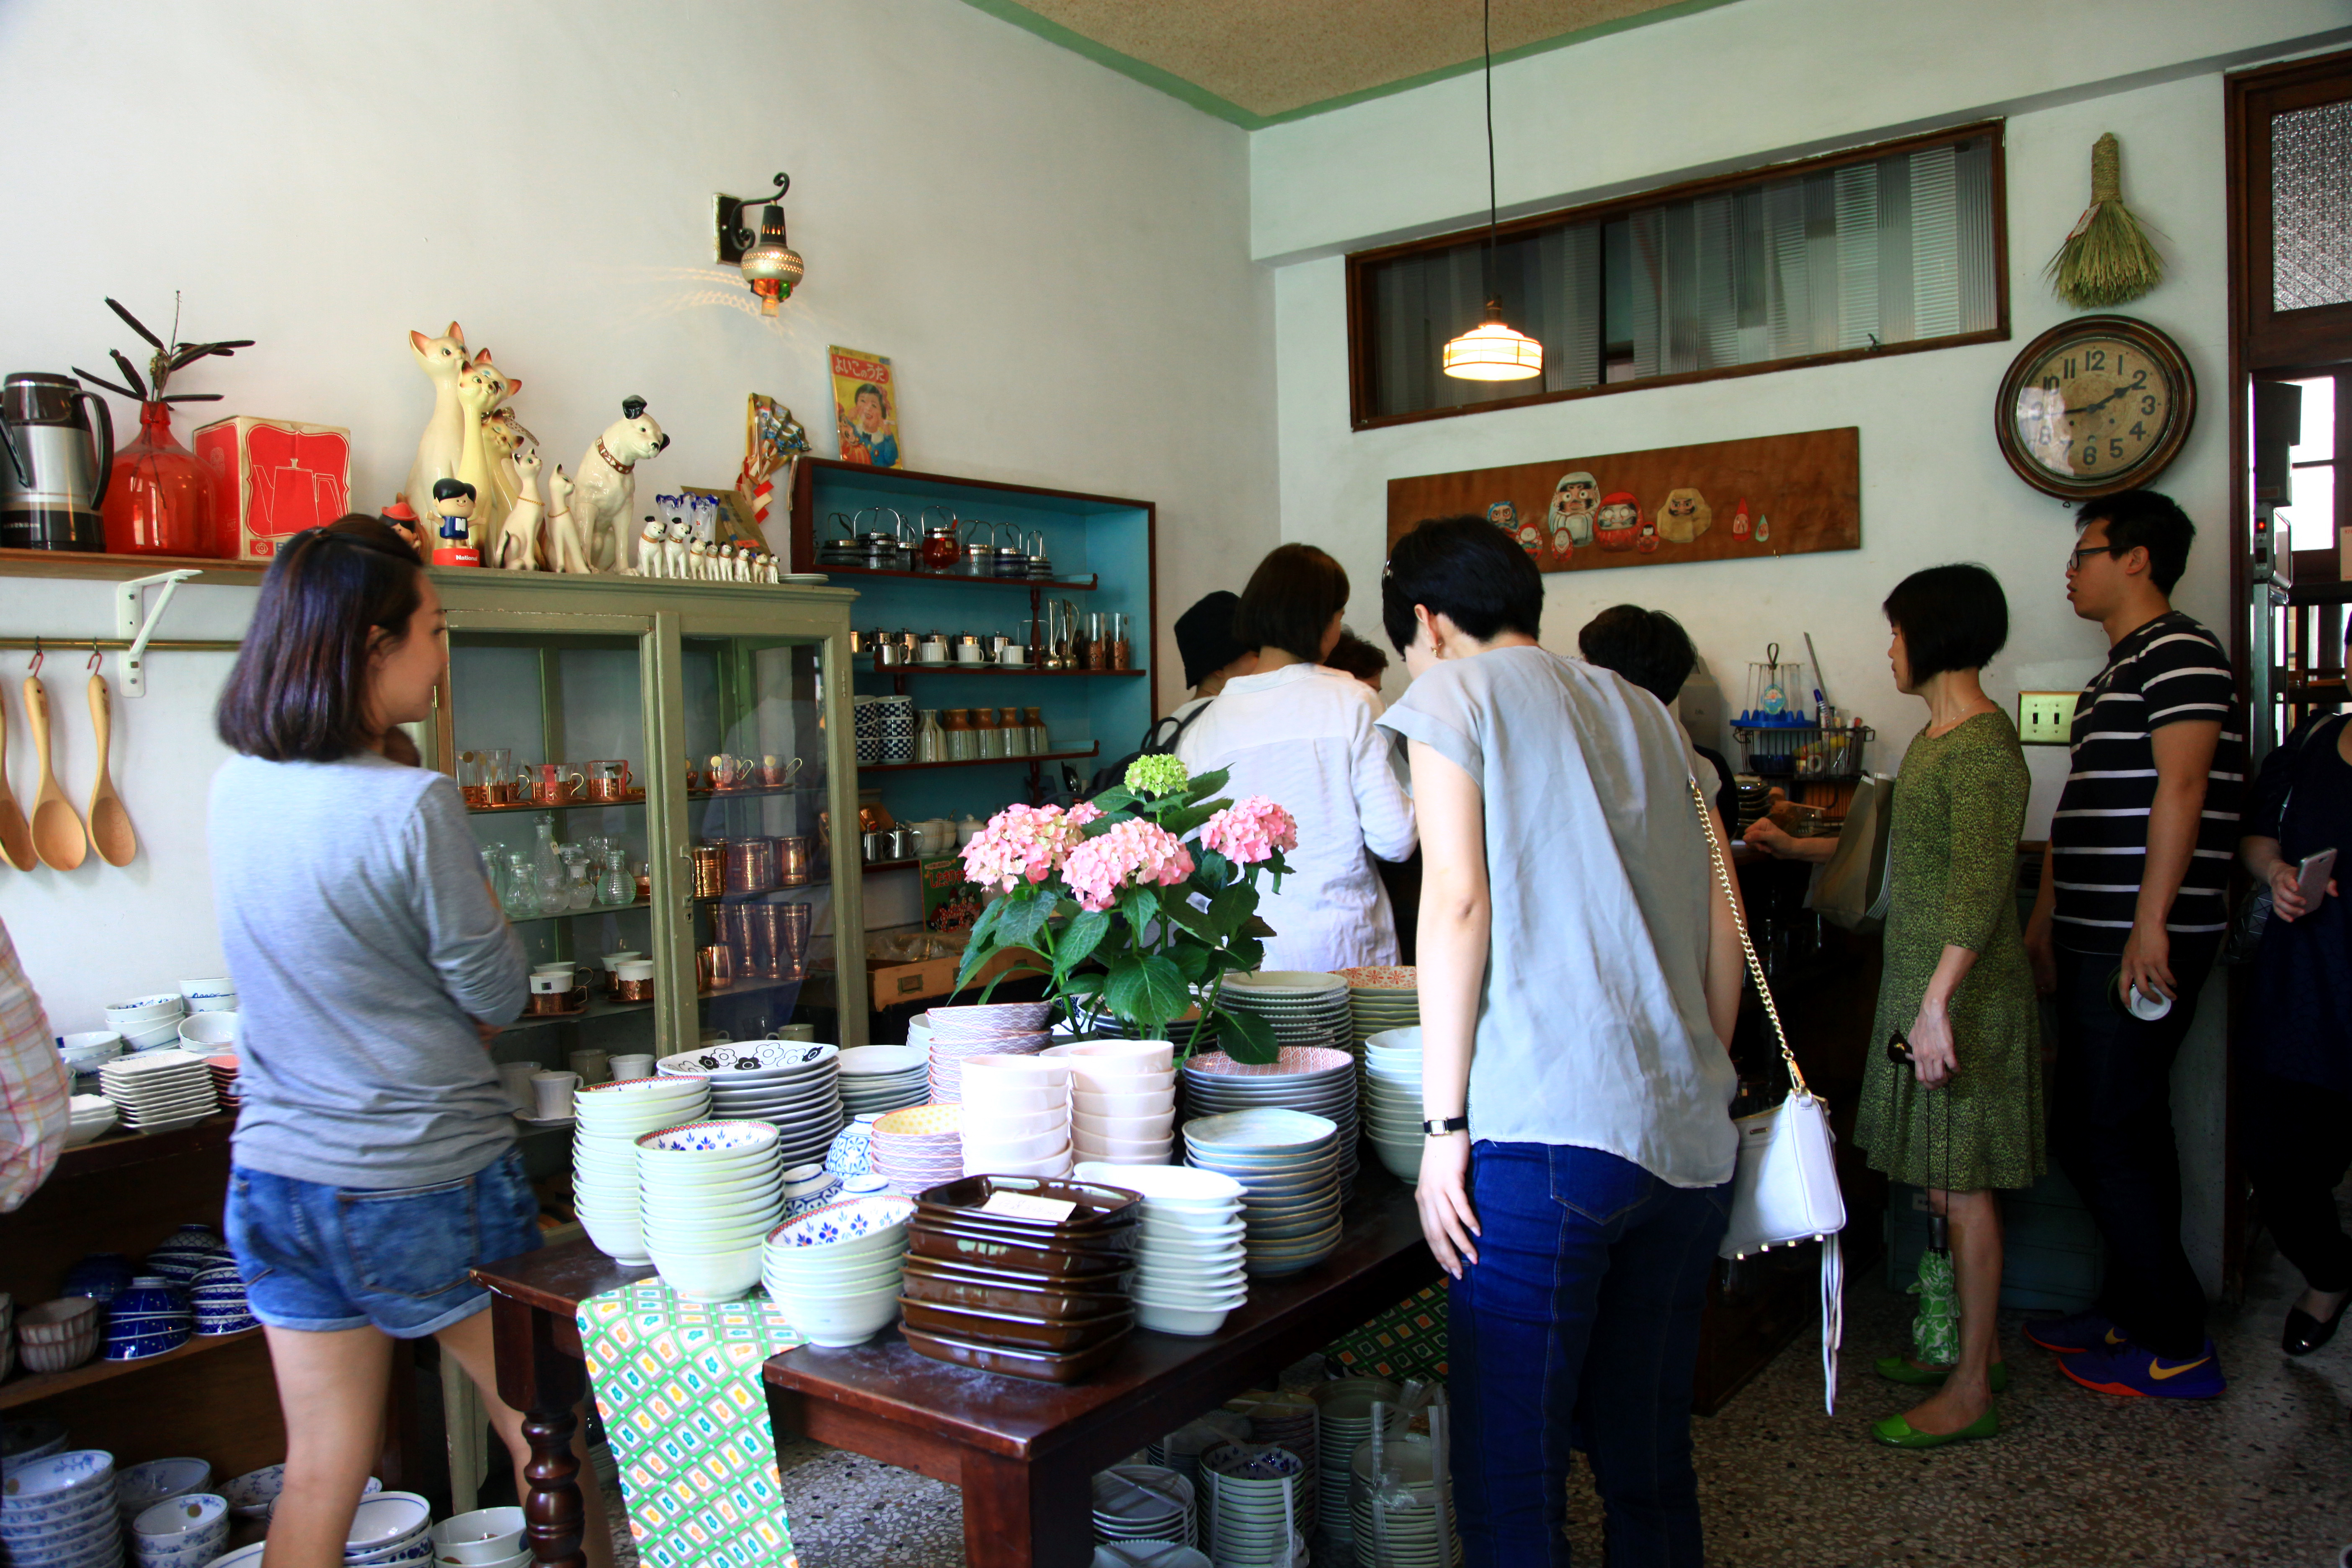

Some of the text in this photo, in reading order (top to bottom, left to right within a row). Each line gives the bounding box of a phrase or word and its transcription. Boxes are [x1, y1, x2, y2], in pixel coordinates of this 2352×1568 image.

[835, 357, 885, 382] よいこのうた
[2064, 359, 2075, 379] 11
[2085, 350, 2105, 371] 12
[2119, 355, 2123, 375] 1
[2043, 376, 2059, 395] 10
[2132, 370, 2146, 390] 2
[2141, 395, 2156, 415] 3
[2039, 426, 2051, 445] 8
[2130, 421, 2146, 441] 4
[2060, 440, 2074, 460] 7
[2083, 446, 2097, 465] 6
[2110, 438, 2123, 458] 5
[455, 518, 466, 531] N
